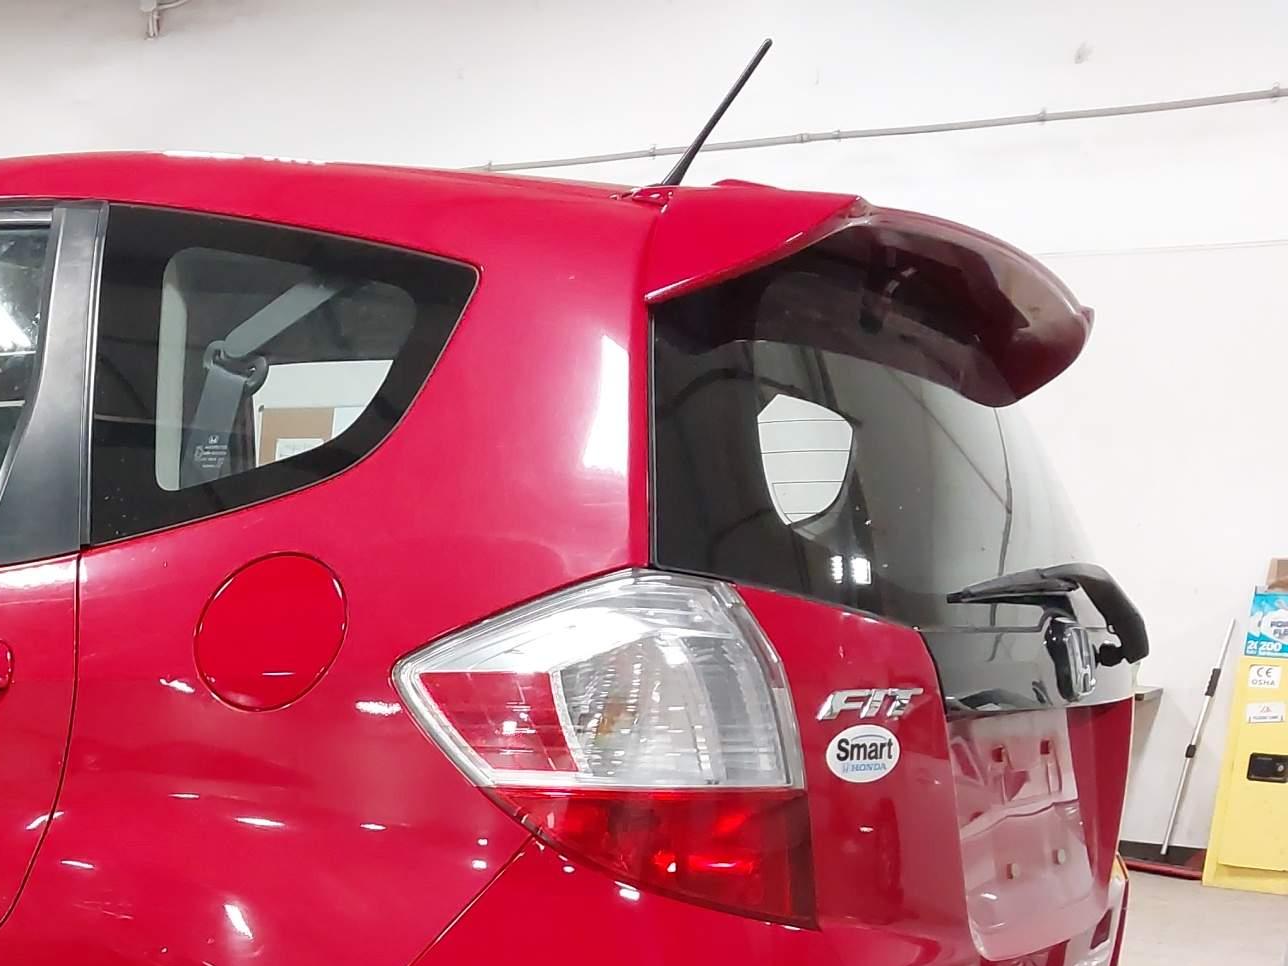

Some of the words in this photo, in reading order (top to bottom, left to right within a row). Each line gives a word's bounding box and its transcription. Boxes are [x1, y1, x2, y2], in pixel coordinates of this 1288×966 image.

[1259, 641, 1282, 652] 200
[1257, 667, 1273, 678] CE
[836, 738, 893, 762] Smart
[851, 762, 887, 772] HONDA
